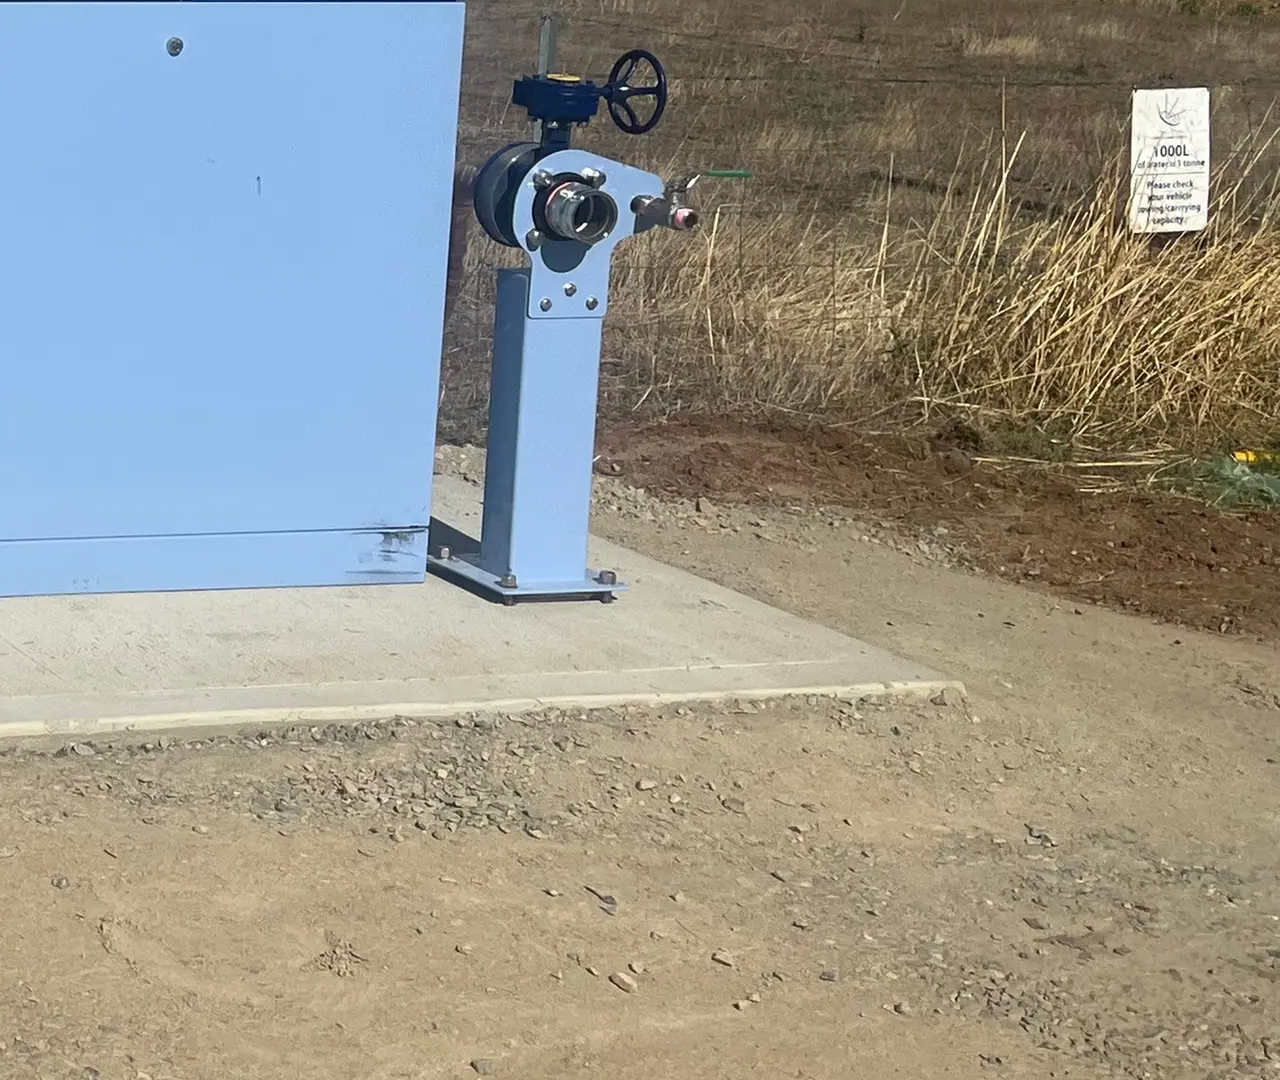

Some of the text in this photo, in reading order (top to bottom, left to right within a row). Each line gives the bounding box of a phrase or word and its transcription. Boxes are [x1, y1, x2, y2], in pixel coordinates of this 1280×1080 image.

[1153, 144, 1190, 157] 1000L
[1137, 160, 1145, 169] of
[1183, 159, 1206, 167] tonne
[1147, 179, 1194, 189] Please check
[1166, 192, 1193, 200] vehicle
